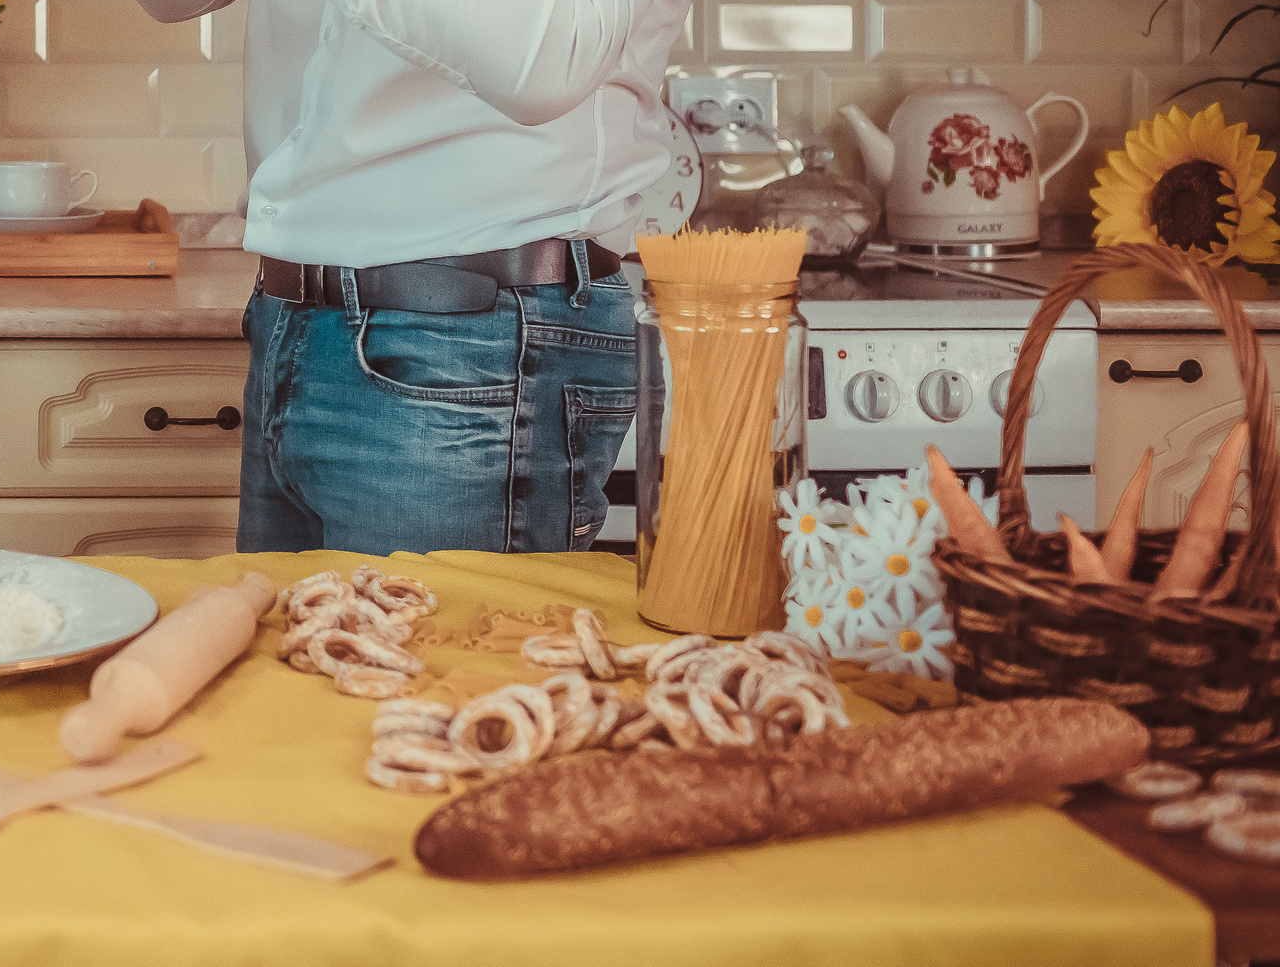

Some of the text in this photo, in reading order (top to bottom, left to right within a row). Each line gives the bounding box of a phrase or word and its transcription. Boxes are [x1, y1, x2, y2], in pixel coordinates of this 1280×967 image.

[676, 154, 695, 179] 3
[669, 190, 684, 212] 4
[645, 217, 662, 236] 5
[957, 223, 1003, 234] GALAXY
